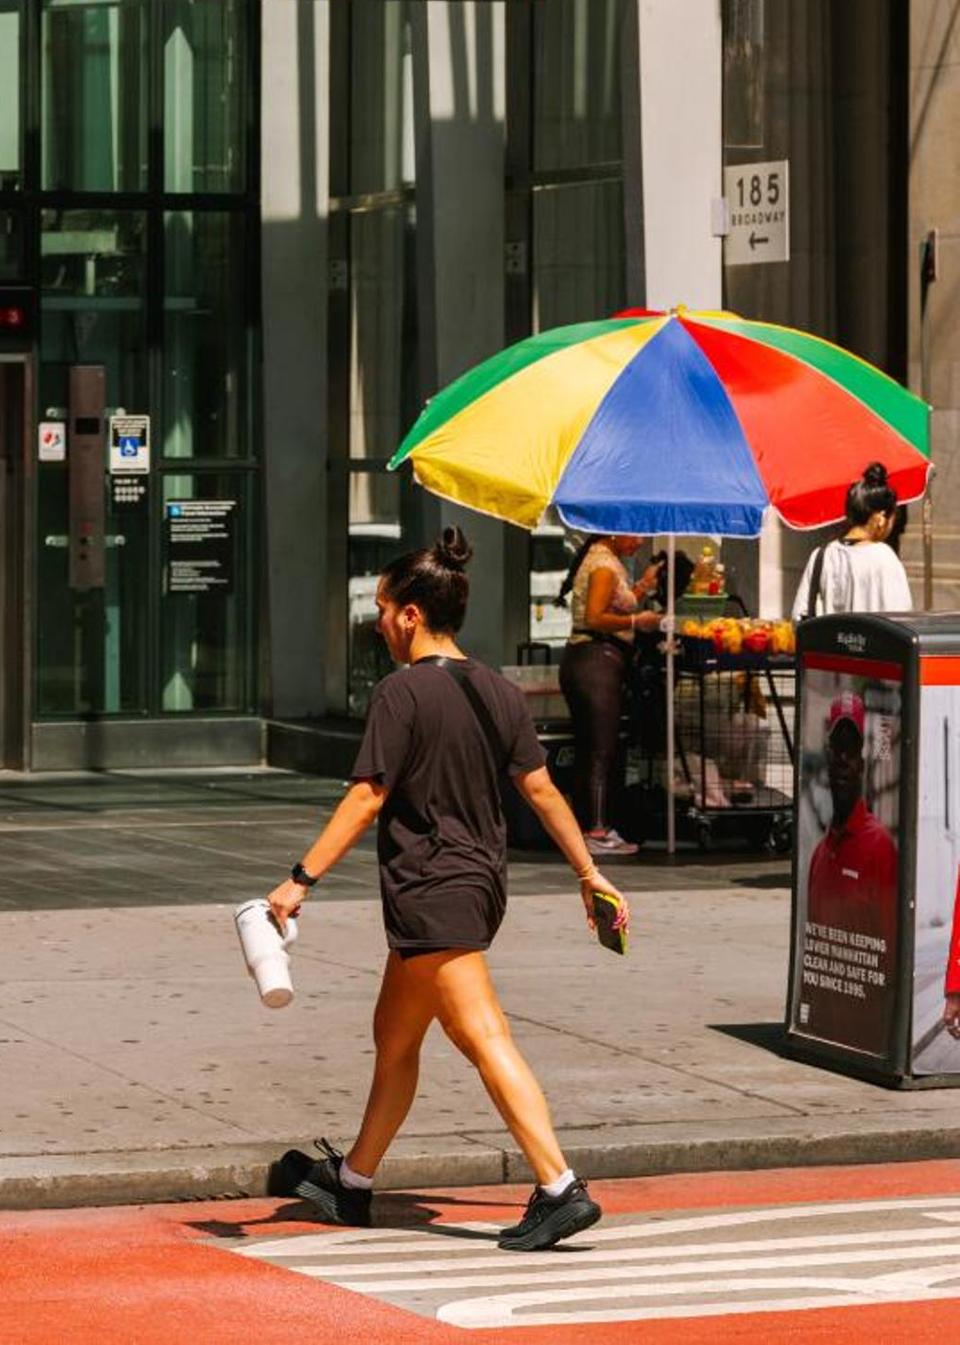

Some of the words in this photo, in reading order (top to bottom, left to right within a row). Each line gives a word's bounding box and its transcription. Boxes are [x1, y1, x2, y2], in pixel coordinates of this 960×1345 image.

[737, 173, 779, 207] 185
[732, 211, 785, 226] BROADWAY
[828, 927, 848, 944] BEEN
[849, 933, 886, 952] KEEPING
[803, 969, 819, 986] YOU
[820, 974, 842, 992] SINCE
[804, 954, 828, 971] CLEAN
[829, 960, 845, 976] AND
[846, 964, 866, 982] SAFE
[868, 971, 886, 986] FOR
